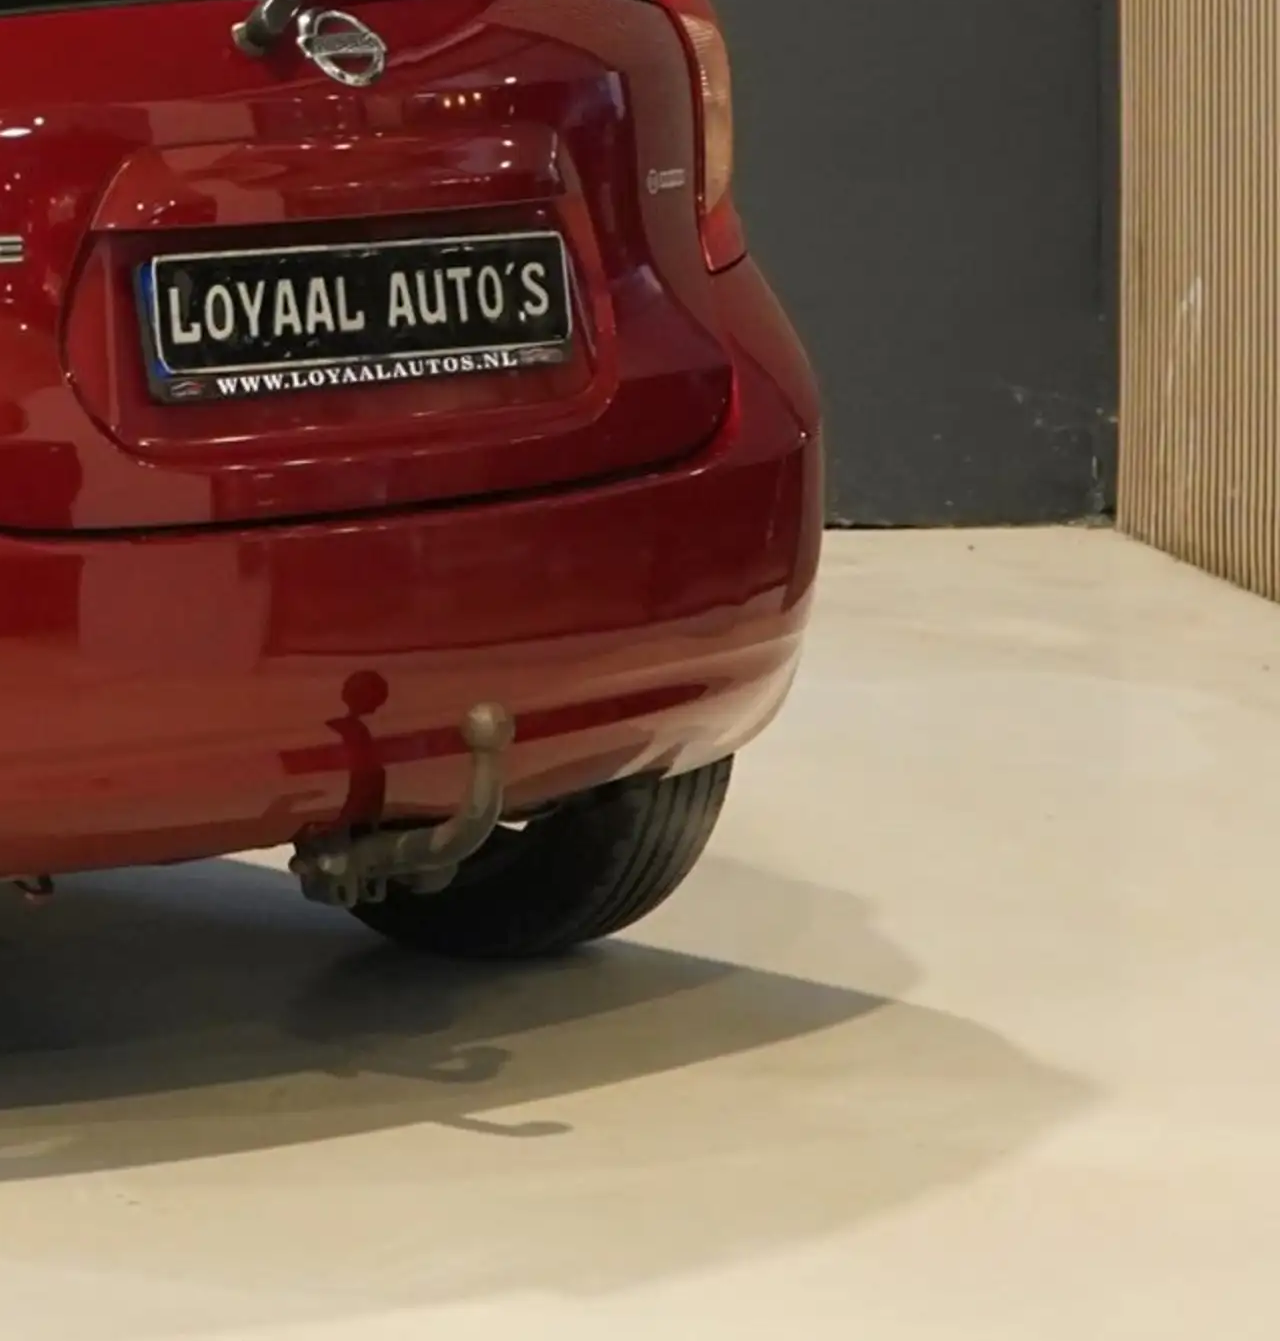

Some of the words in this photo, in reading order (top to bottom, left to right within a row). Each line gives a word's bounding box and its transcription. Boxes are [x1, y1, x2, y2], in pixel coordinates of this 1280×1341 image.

[170, 275, 365, 344] LOYAAL
[388, 262, 551, 327] AUTO'S
[216, 350, 518, 396] WWW.LOYAALAUTOS.NL
